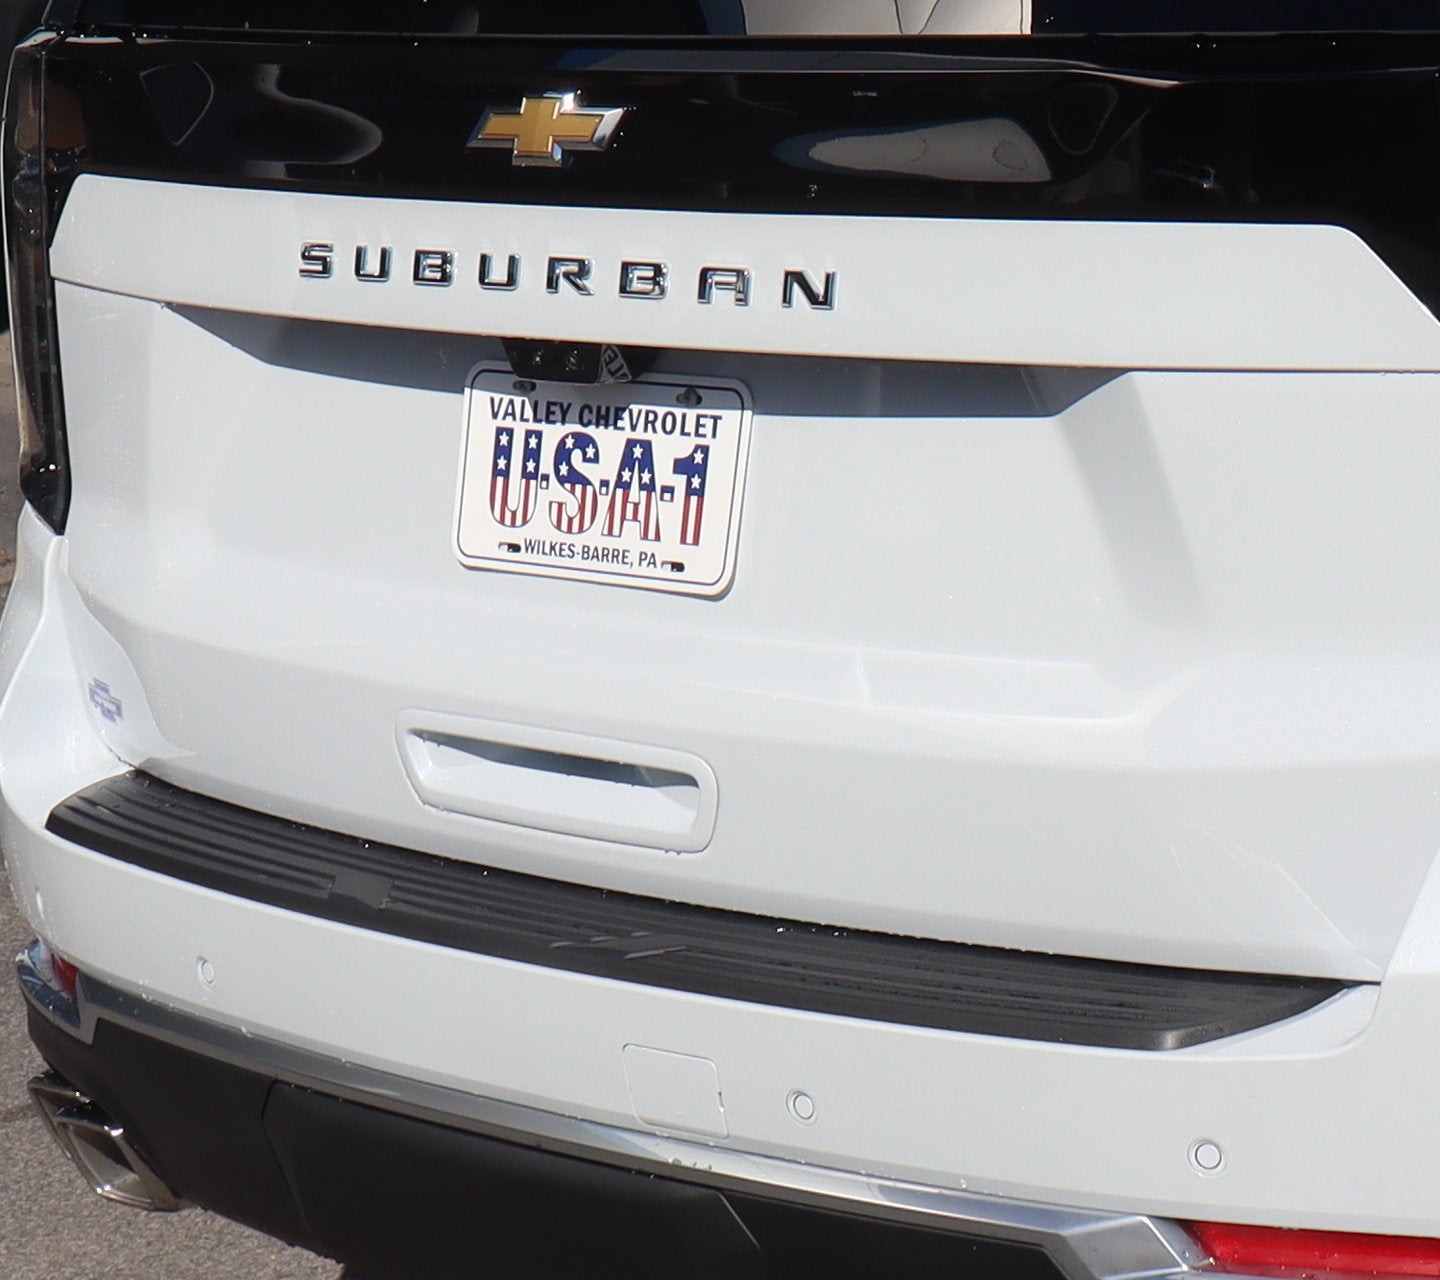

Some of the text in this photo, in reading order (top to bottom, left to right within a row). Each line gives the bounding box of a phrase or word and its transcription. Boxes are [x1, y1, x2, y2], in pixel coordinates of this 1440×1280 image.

[298, 240, 838, 311] SUBURBAN
[489, 395, 723, 439] VALLEY CHEVROLET
[523, 537, 658, 569] WILKES-BARRE, PA
